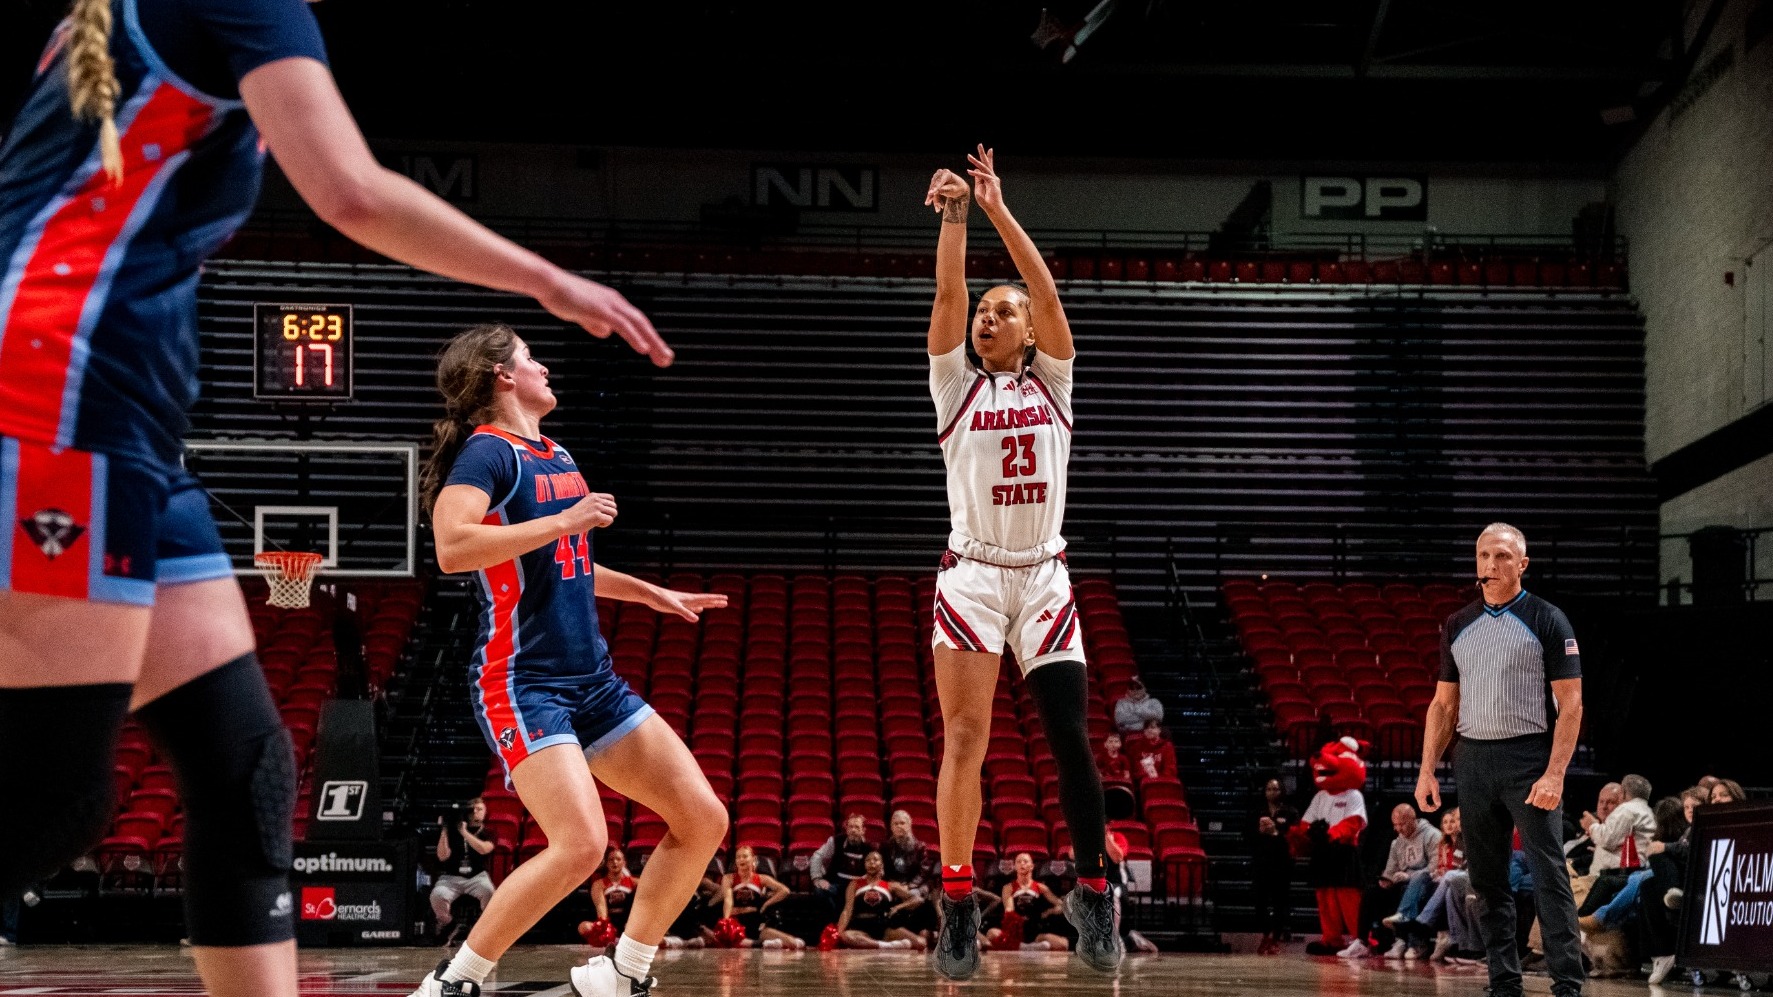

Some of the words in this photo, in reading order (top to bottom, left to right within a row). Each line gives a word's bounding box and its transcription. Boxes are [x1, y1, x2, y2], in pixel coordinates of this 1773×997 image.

[756, 167, 873, 208] NN
[1304, 176, 1422, 216] PP
[283, 314, 342, 341] 6:23
[295, 343, 332, 387] 17
[1001, 433, 1037, 478] 23
[991, 482, 1047, 506] STATE
[554, 531, 592, 580] 44
[293, 852, 393, 874] optimum.
[361, 931, 401, 939] GARED
